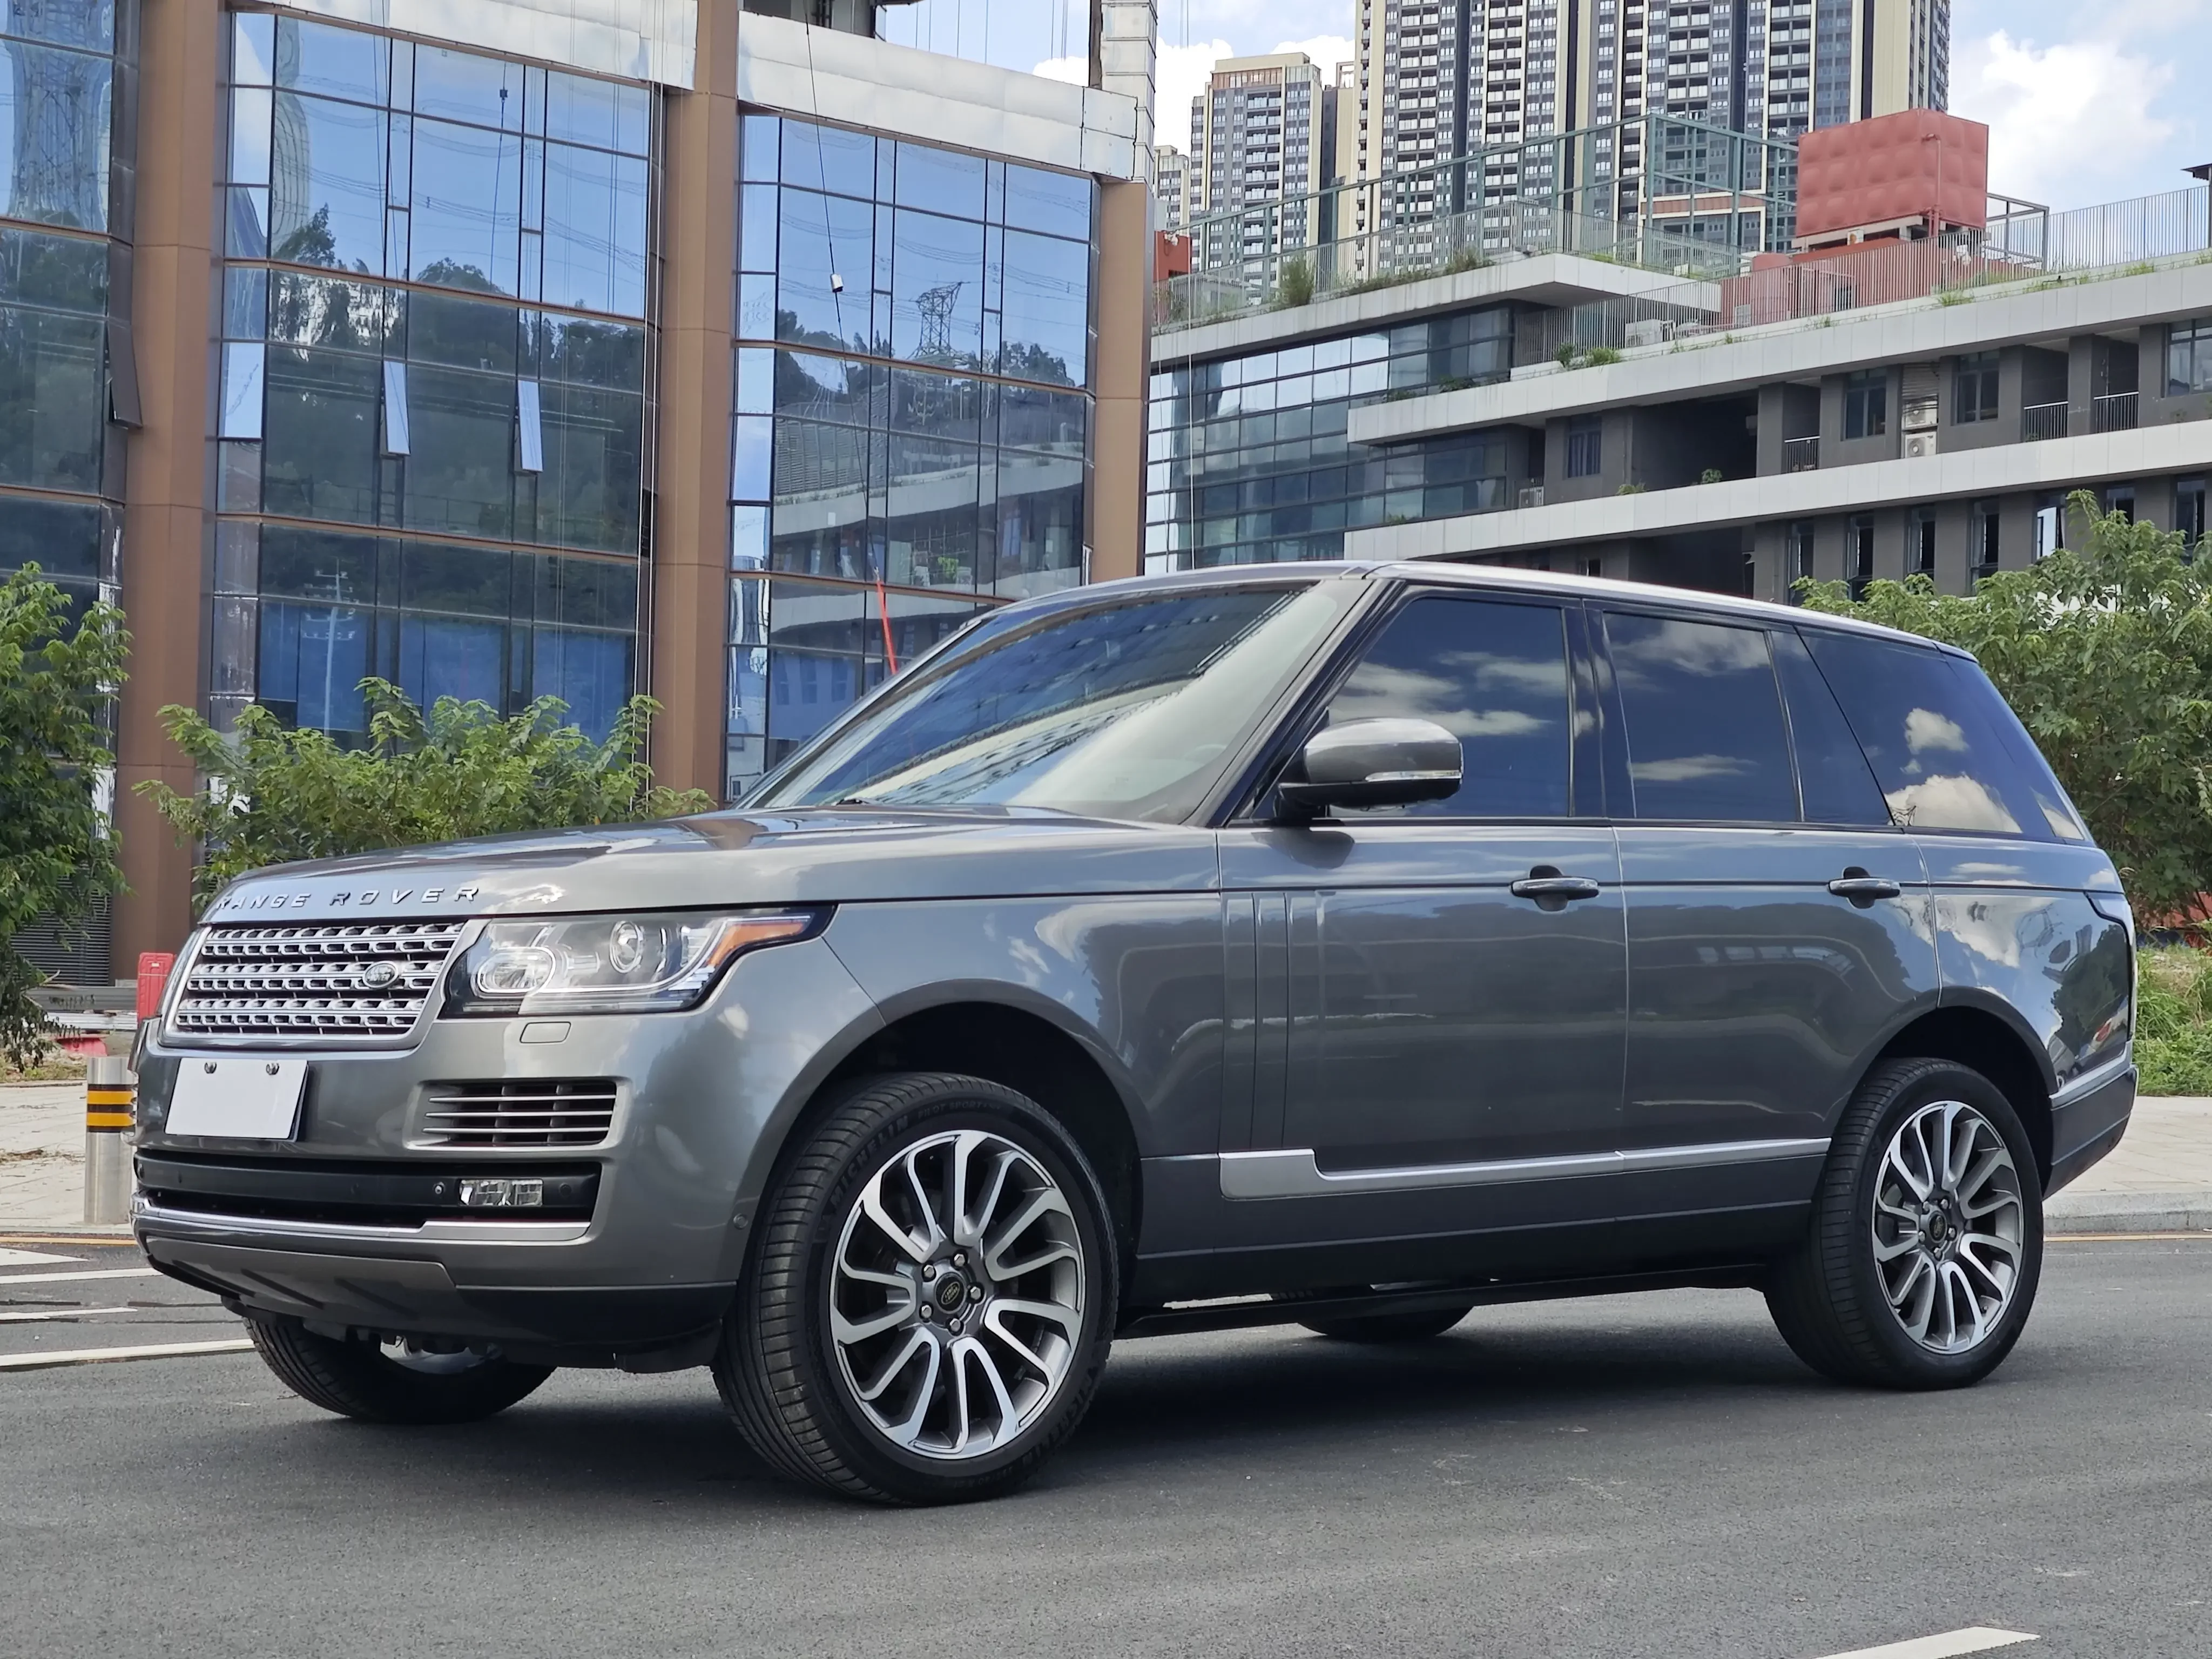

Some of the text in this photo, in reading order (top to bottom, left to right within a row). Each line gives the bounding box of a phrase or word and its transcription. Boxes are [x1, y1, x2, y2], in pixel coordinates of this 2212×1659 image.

[215, 886, 480, 910] RANGE ROVER
[830, 1115, 908, 1206] MICHELIN
